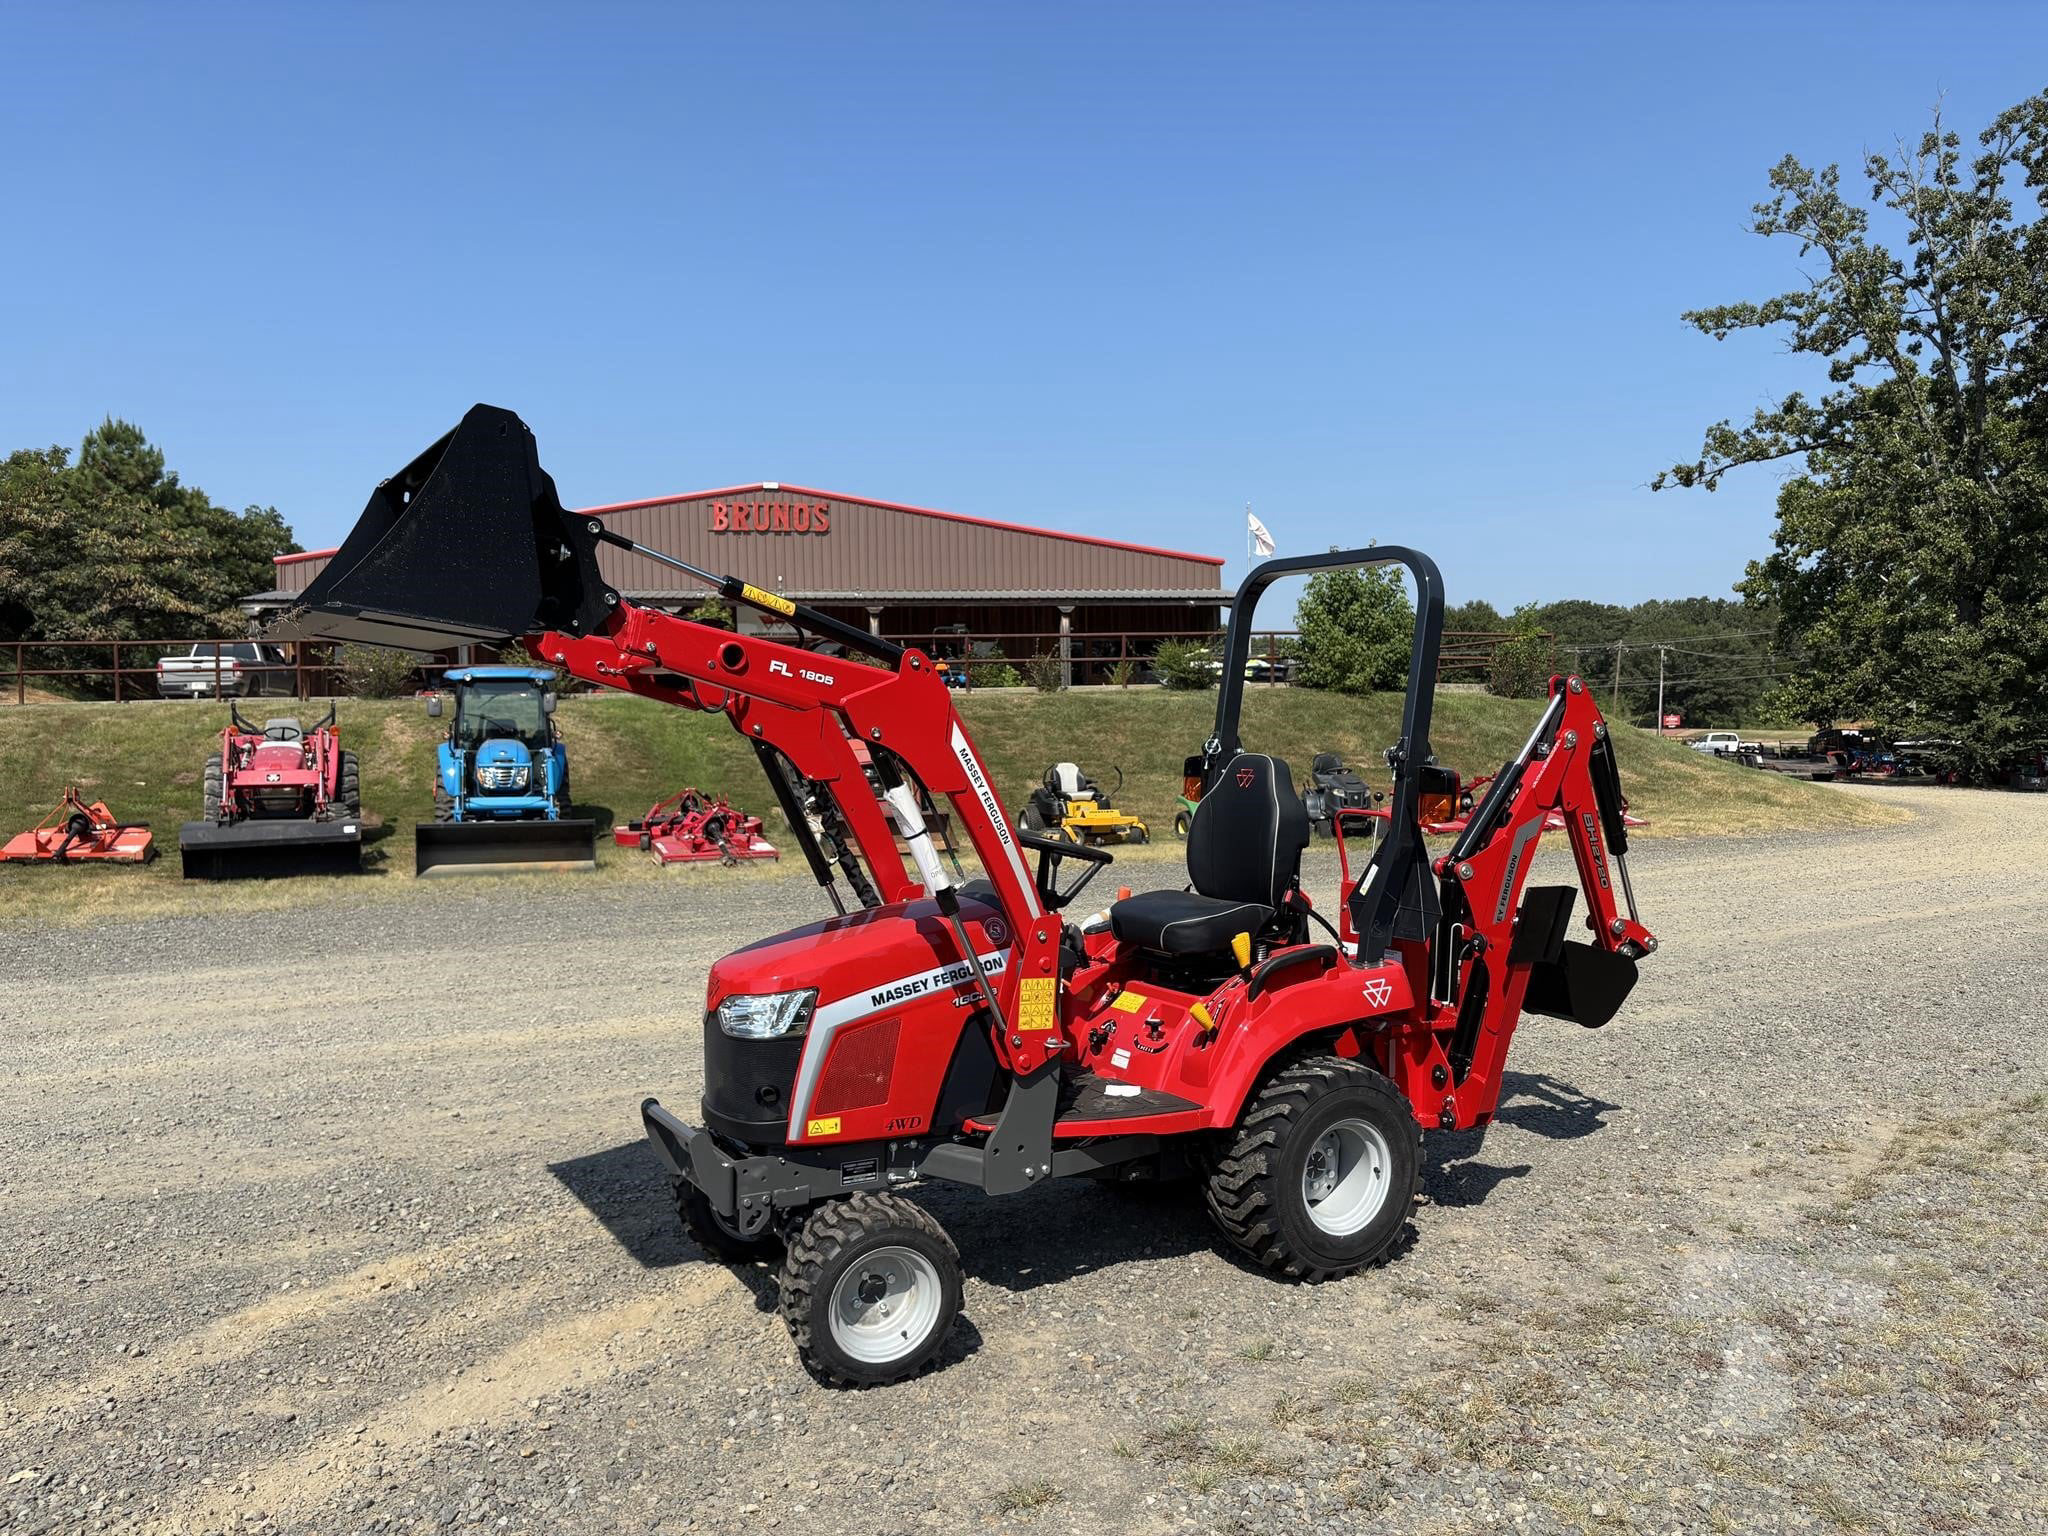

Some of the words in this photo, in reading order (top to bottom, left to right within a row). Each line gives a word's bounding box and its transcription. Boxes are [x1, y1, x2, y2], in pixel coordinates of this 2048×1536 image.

[768, 659, 794, 678] FL
[799, 669, 834, 685] 1805
[959, 747, 985, 789] MASSEY
[981, 790, 1011, 845] FERGUSON
[1500, 854, 1518, 907] FERGUSON
[871, 978, 929, 1007] MASSEY
[886, 1116, 922, 1131] 4WD
